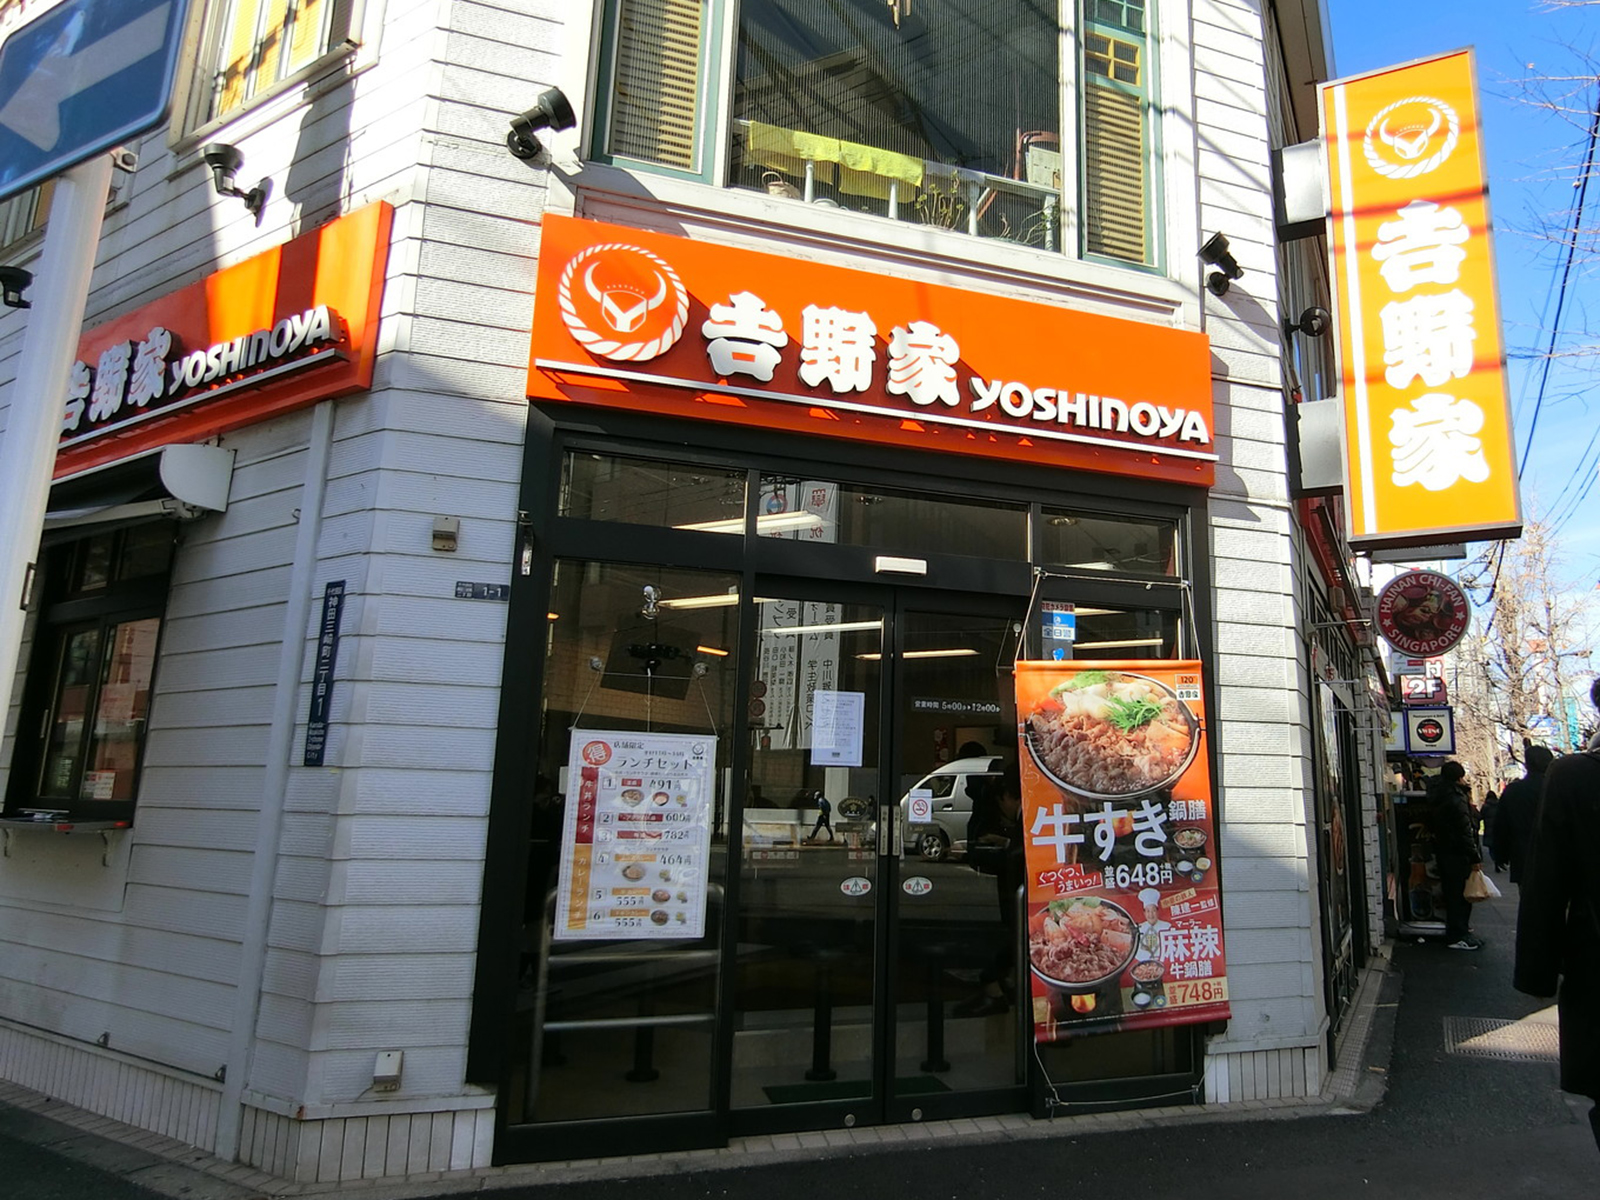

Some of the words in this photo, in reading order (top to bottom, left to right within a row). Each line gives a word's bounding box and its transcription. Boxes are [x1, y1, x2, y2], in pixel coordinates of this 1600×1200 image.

[168, 304, 334, 395] YOSHINOYA
[1371, 199, 1490, 492] 吉野家
[701, 290, 961, 407] 吉野家
[969, 375, 1210, 445] YOSHINOYA
[482, 586, 502, 598] 1-1
[1380, 576, 1418, 614] HAINAN
[1418, 573, 1464, 607] CHI-FAN
[1388, 623, 1462, 653] SINGAPORE
[1180, 676, 1194, 684] 120
[1408, 678, 1442, 699] 2F
[587, 744, 606, 762] 得
[616, 756, 694, 770] ランチセット
[1168, 800, 1207, 821] 鍋膳
[1030, 800, 1168, 864] 牛すき
[1115, 863, 1174, 889] 648円
[616, 896, 645, 906] 555円
[614, 918, 643, 928] 555円
[1175, 918, 1202, 928] マーラー
[1159, 924, 1222, 962] 麻辣
[1170, 960, 1214, 980] 牛鍋膳
[1177, 981, 1224, 1004] 748円
